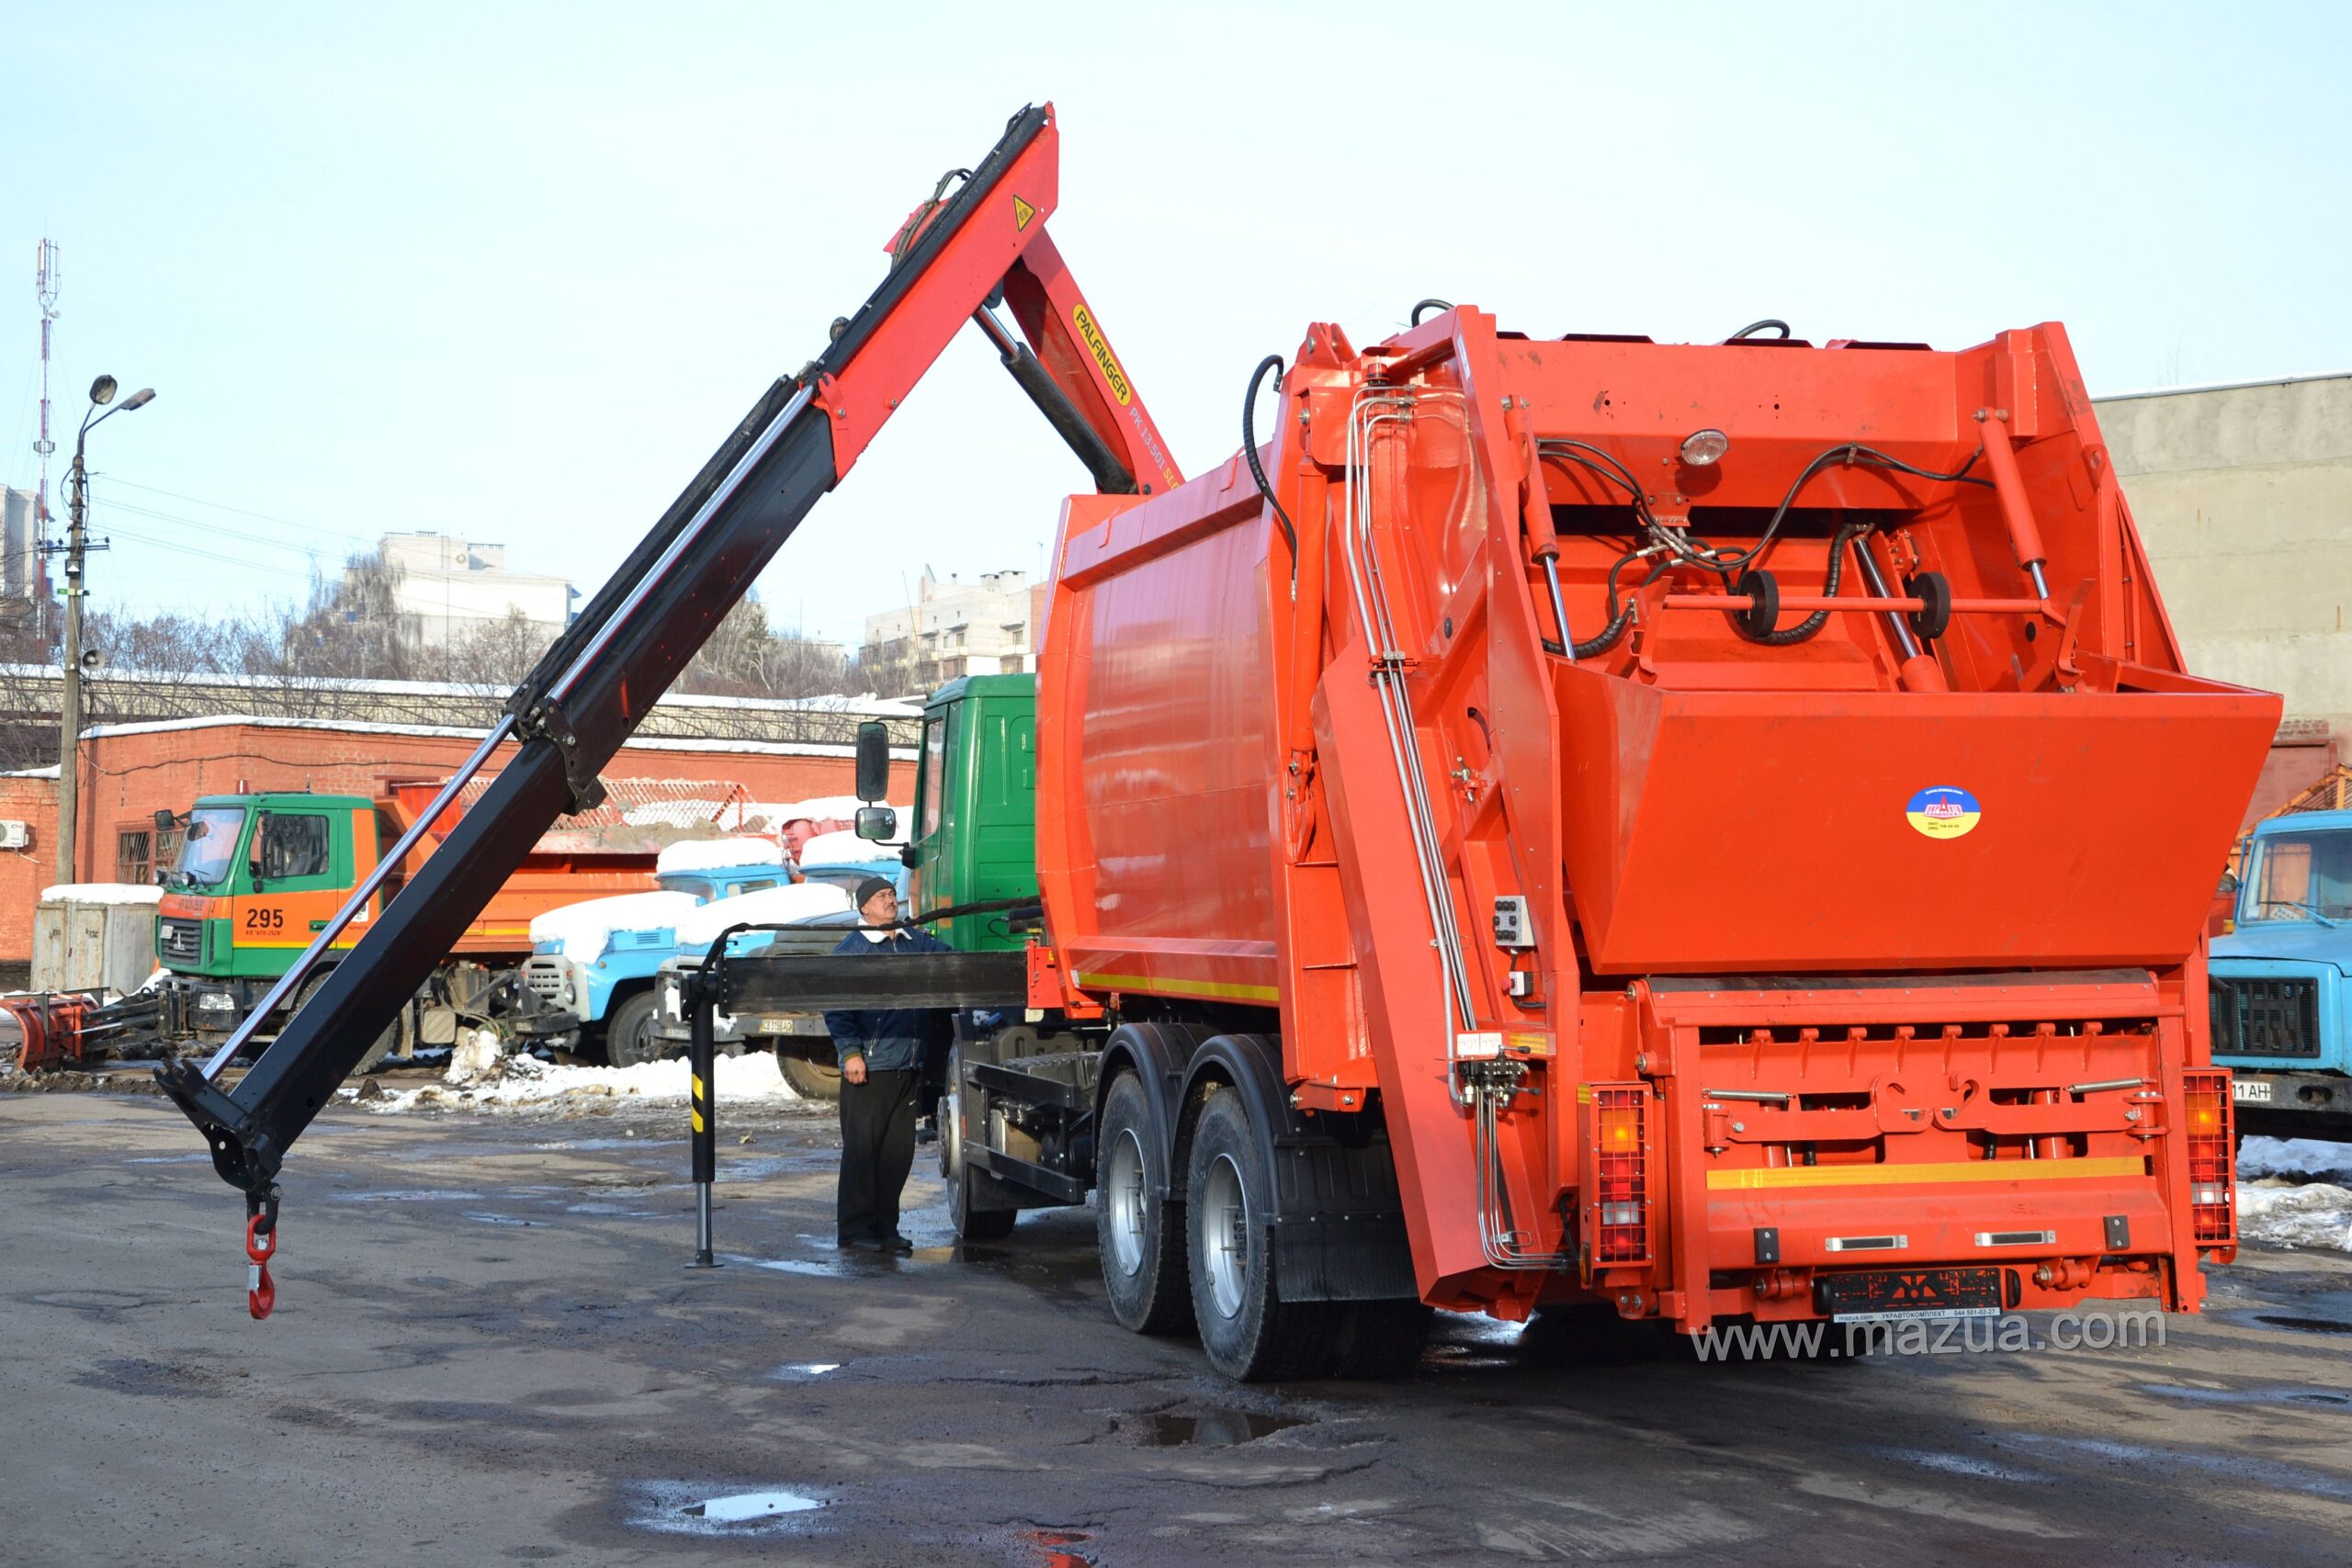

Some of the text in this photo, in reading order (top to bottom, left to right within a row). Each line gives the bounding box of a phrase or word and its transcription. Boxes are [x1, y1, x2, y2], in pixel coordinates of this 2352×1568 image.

[1076, 310, 1128, 400] PALFINGER
[1129, 407, 1143, 430] PK
[246, 908, 284, 929] 295
[2248, 1084, 2267, 1100] AH
[1881, 1310, 1947, 1320] УКРАВТОКОМПЛЕКТ
